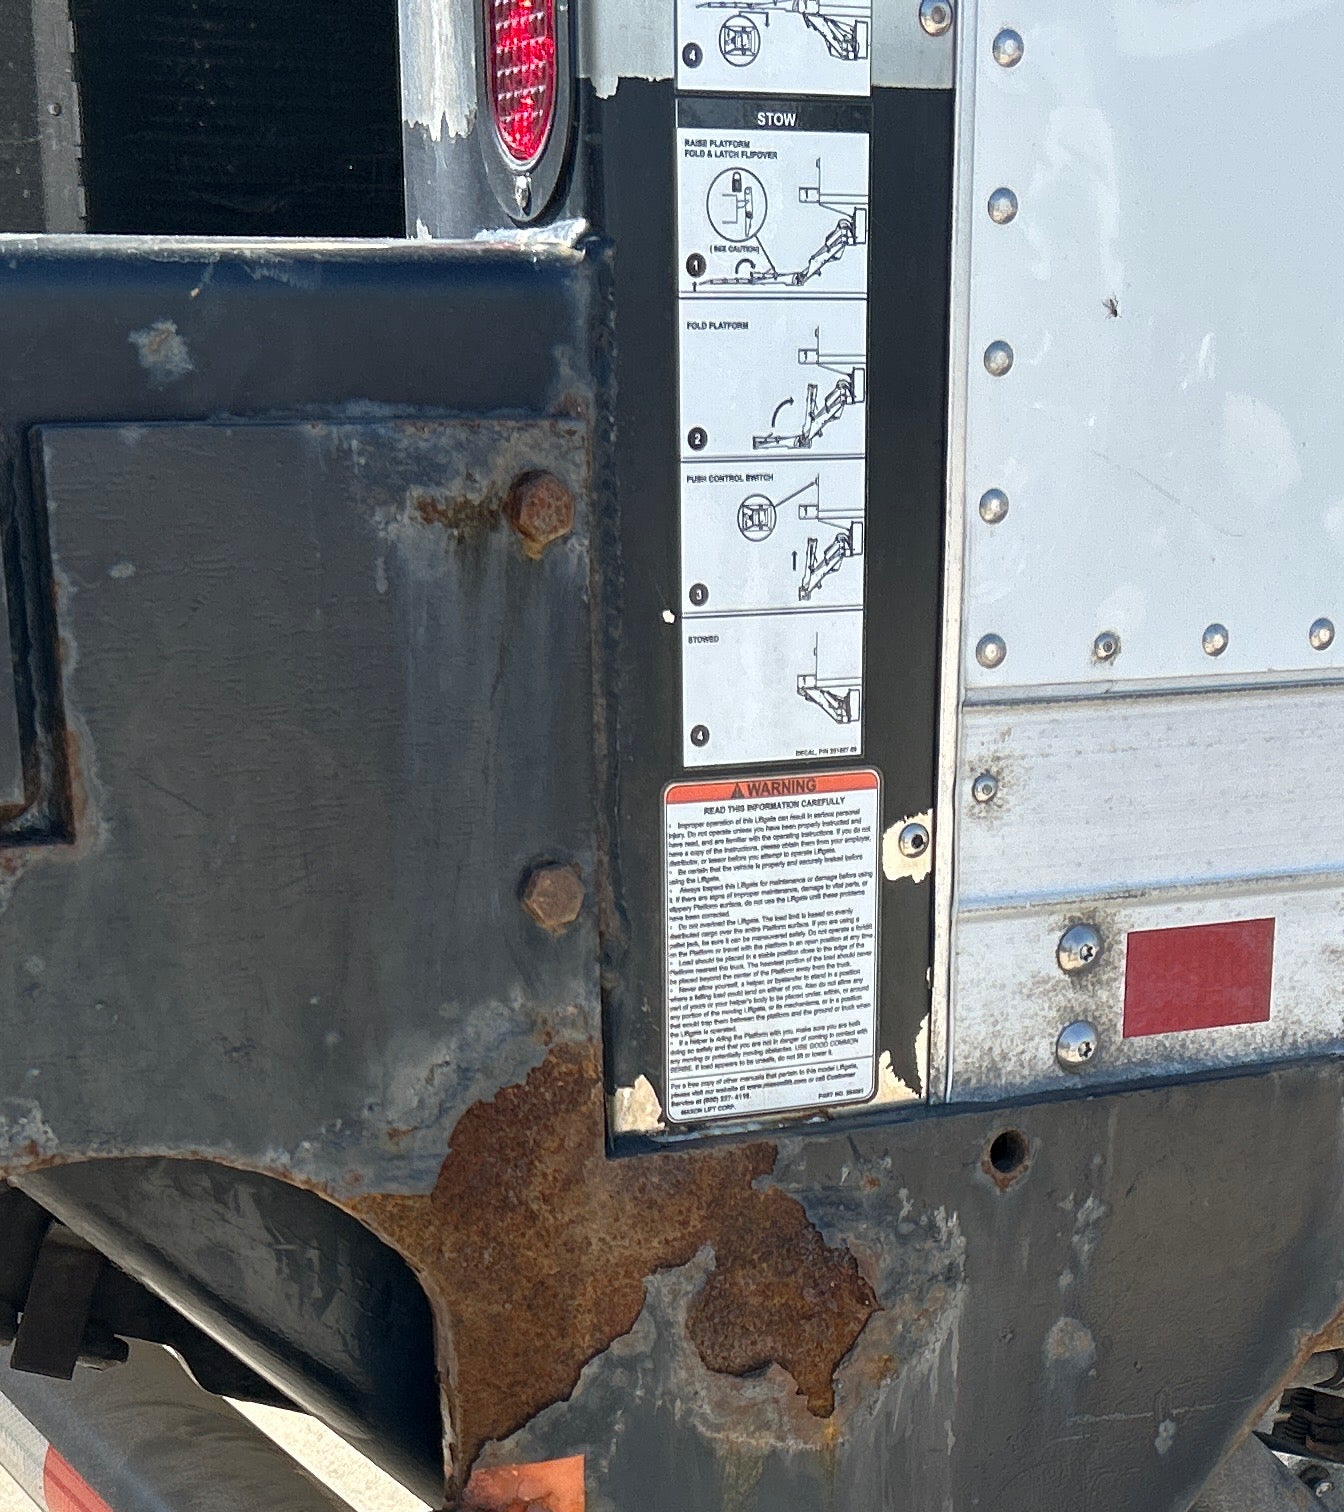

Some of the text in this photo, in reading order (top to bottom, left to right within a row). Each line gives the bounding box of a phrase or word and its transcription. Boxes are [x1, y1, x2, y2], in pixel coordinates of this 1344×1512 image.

[757, 111, 797, 127] STOW
[747, 777, 817, 797] WARNING
[703, 805, 725, 815] READ
[800, 795, 845, 807] CAREFULLY
